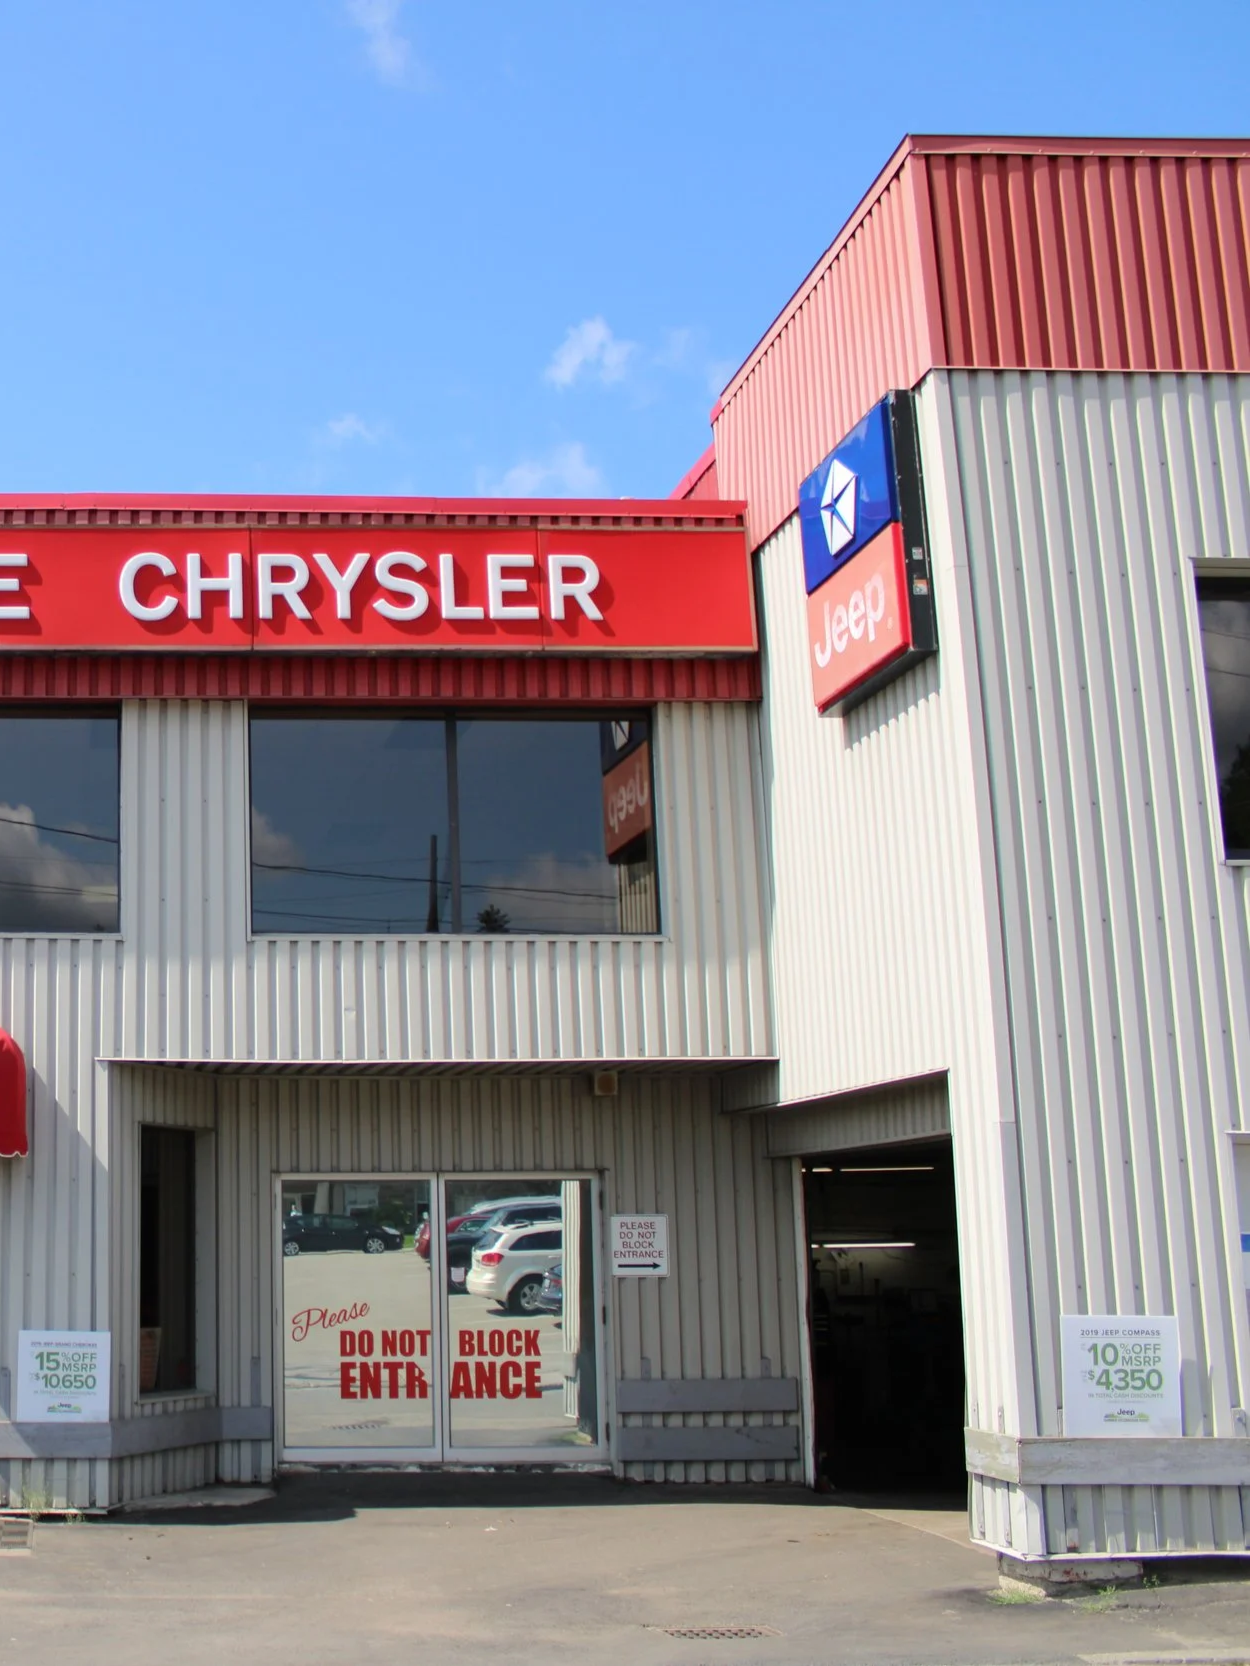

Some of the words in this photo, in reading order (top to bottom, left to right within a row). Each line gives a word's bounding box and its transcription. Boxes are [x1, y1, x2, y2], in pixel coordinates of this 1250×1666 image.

[118, 551, 605, 623] CHRYSLER
[814, 572, 886, 668] Jeep
[620, 1221, 656, 1230] PLEASE
[619, 1231, 634, 1240] DO
[637, 1231, 657, 1240] NOT
[622, 1240, 655, 1249] BLOCK
[613, 1250, 665, 1259] ENTRANCE
[291, 1302, 371, 1343] Please
[1121, 1329, 1161, 1337] COMPASS
[340, 1329, 374, 1357] DO
[381, 1329, 432, 1357] NOT
[458, 1329, 542, 1357] BLOCK
[1121, 1355, 1162, 1367] MSRP
[62, 1363, 97, 1373] MSRP
[1087, 1368, 1164, 1393] $4,350
[1116, 1408, 1135, 1416] Jeep
